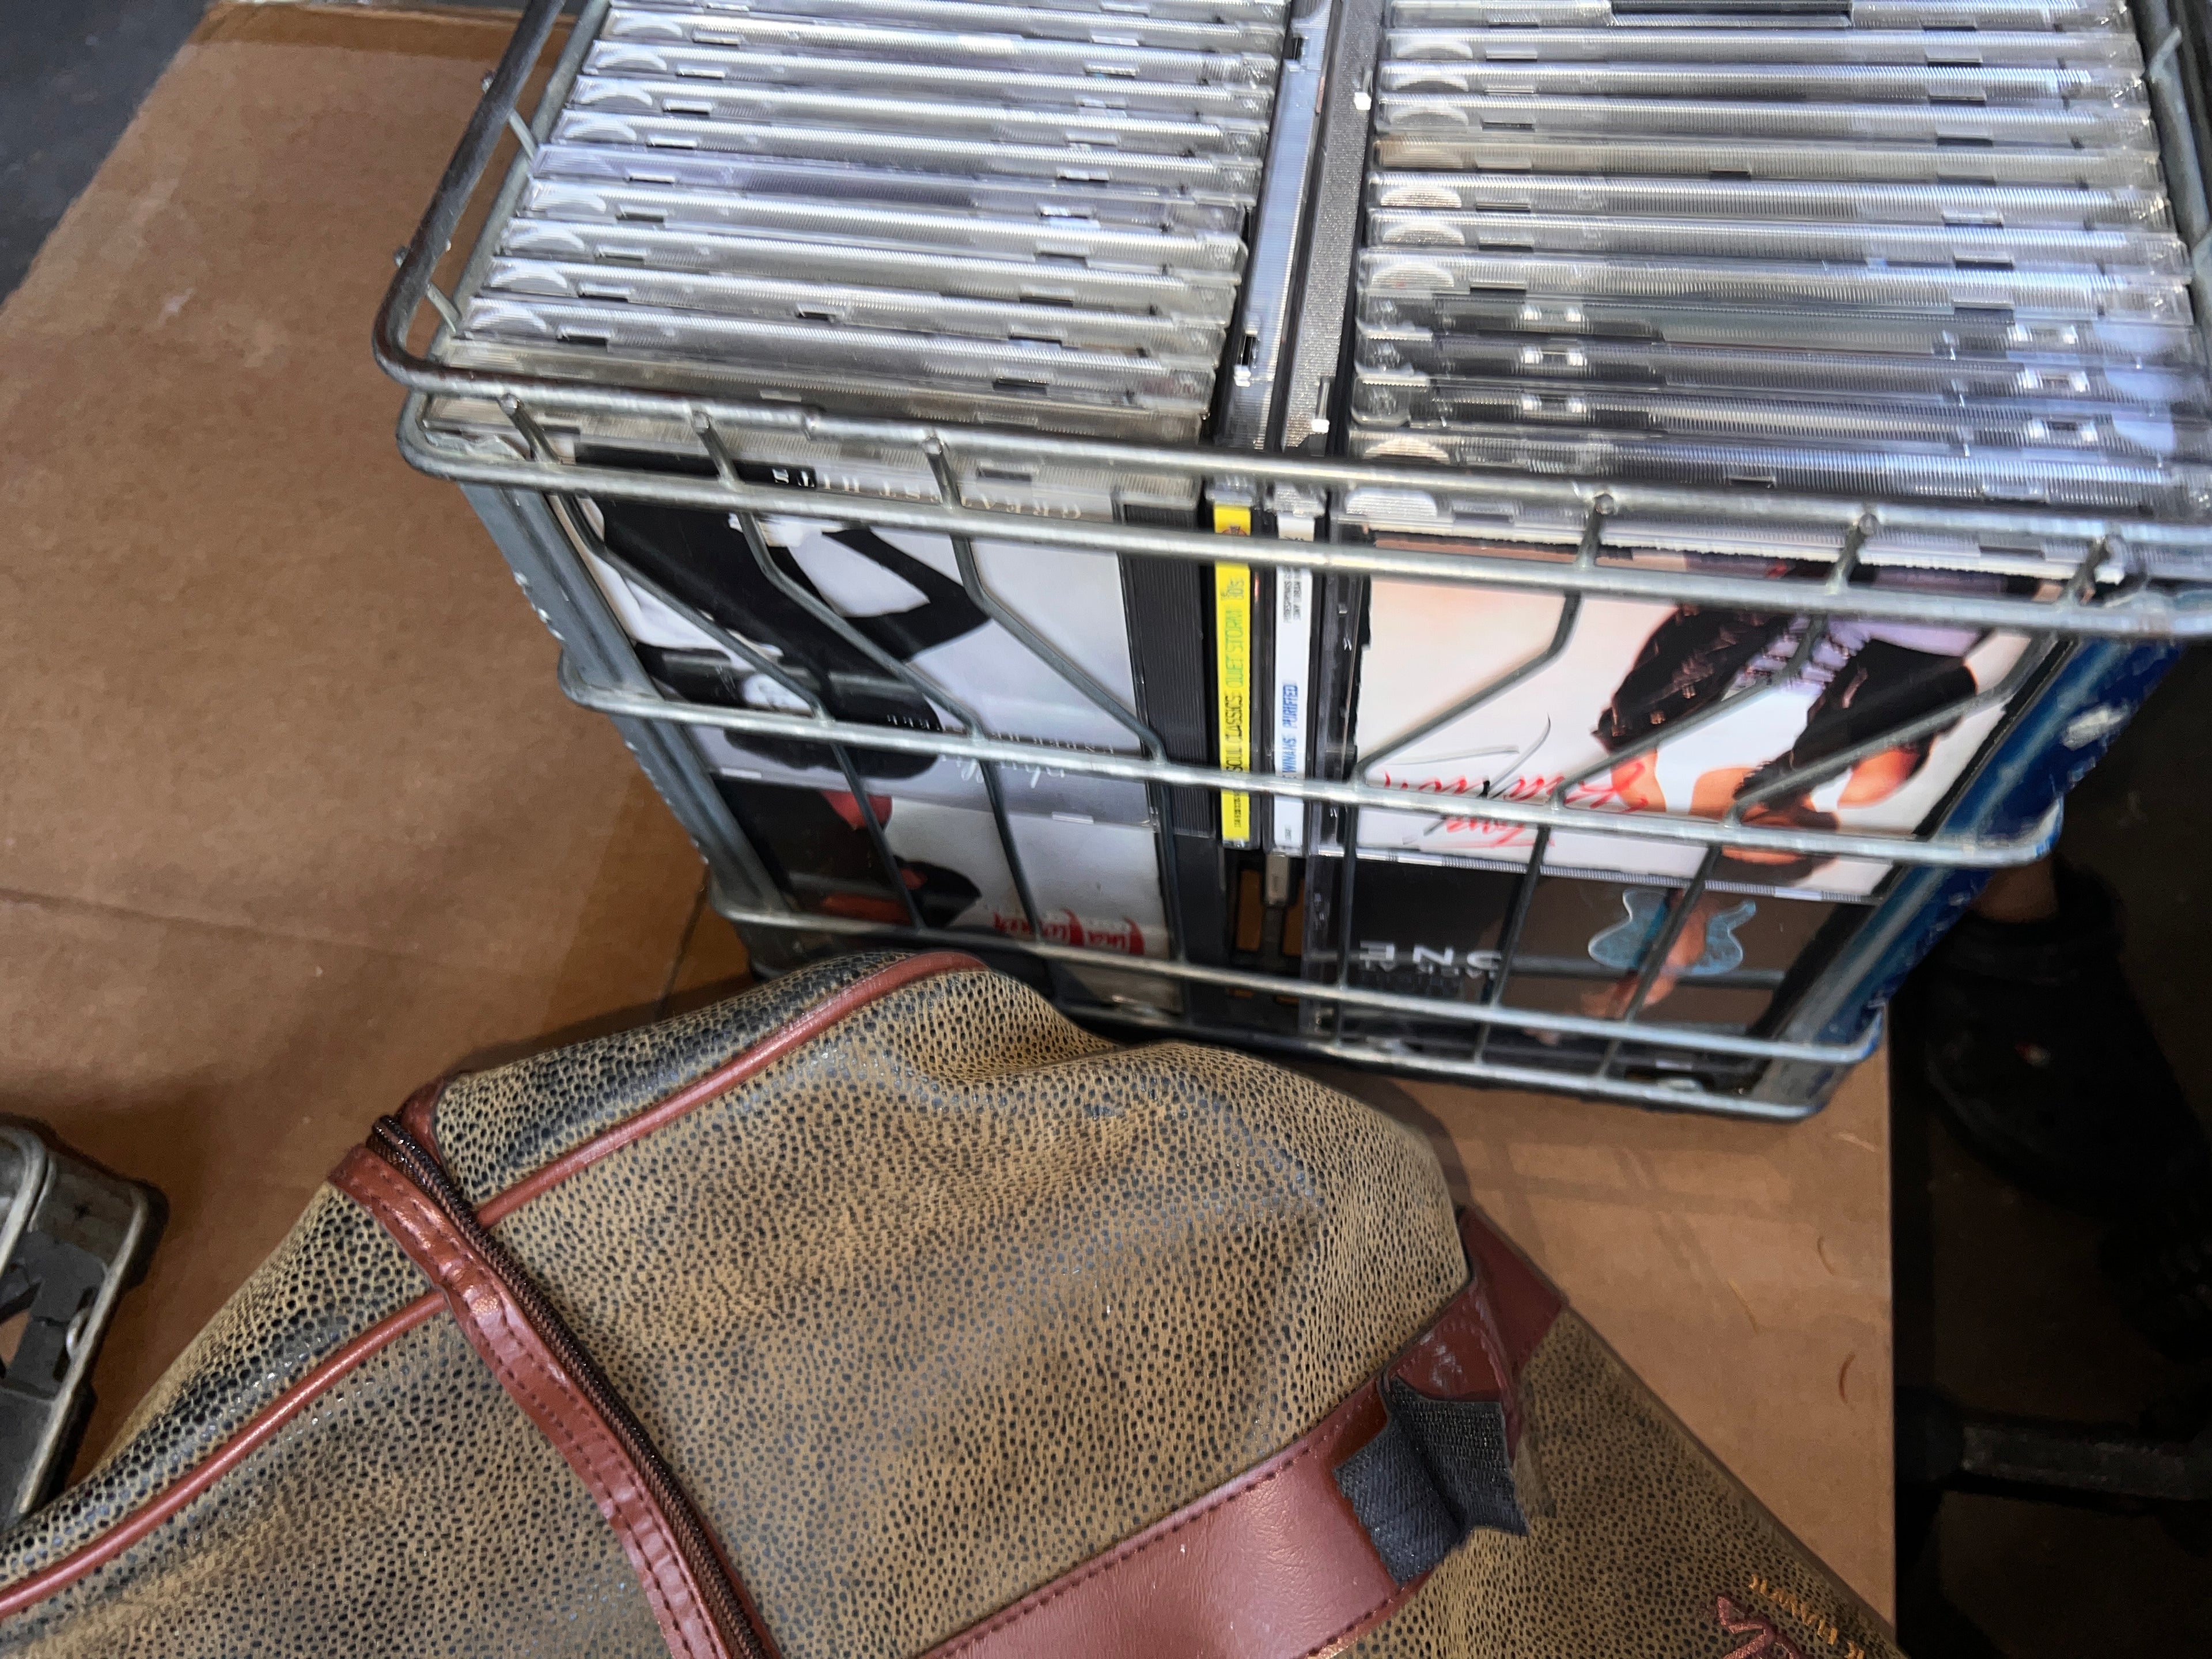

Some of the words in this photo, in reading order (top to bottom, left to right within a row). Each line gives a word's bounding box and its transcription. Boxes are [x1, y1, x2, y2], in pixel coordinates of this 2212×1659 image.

[772, 468, 860, 494] HITS
[1225, 610, 1243, 652] STORM
[1225, 656, 1243, 688] QUIET
[1225, 695, 1242, 743] CLASSICS
[1282, 684, 1297, 729] PURIFIED
[1225, 747, 1243, 772] SOUL
[1282, 738, 1297, 773] WINANS
